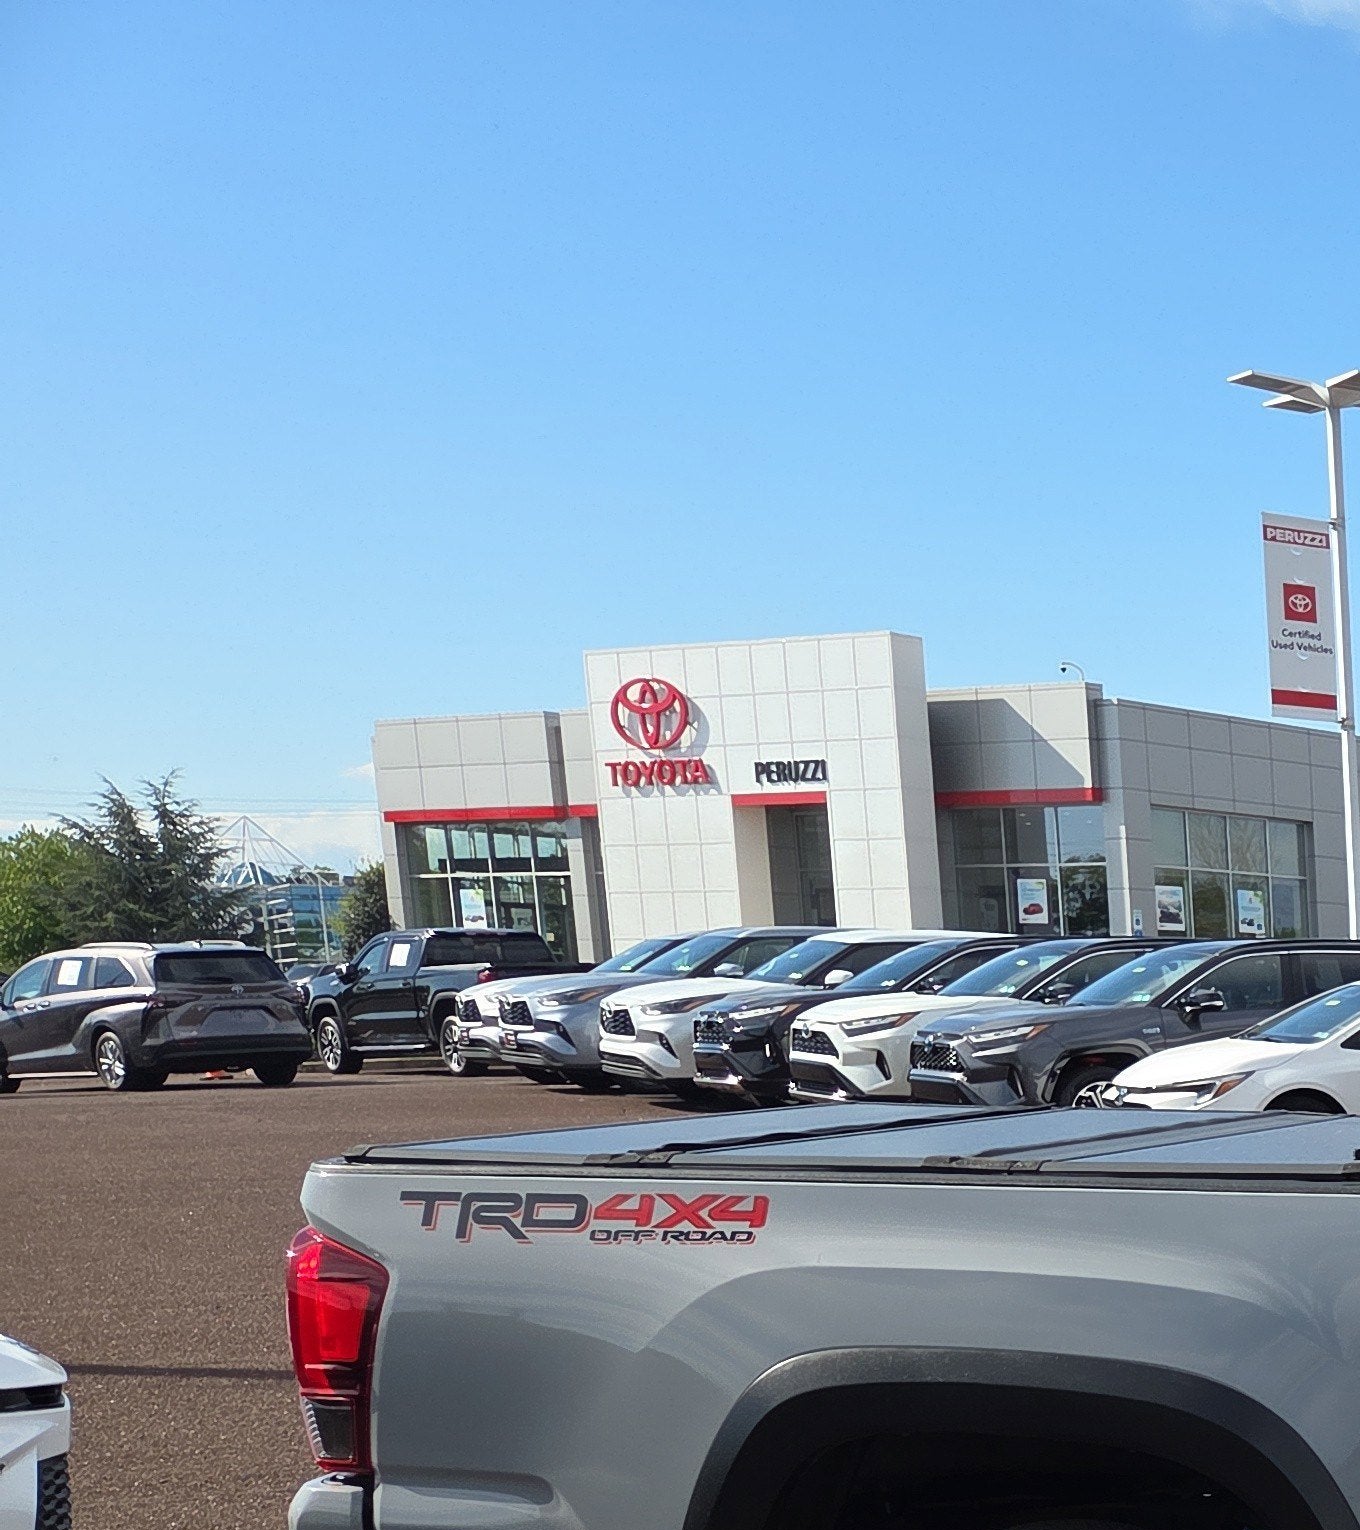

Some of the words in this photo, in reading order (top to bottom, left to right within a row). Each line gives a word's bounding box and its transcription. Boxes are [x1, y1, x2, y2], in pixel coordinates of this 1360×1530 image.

[1266, 527, 1326, 547] PERUZZI
[1281, 628, 1322, 641] Certified
[1271, 639, 1294, 650] Used
[1296, 642, 1333, 654] Vehicles
[605, 758, 711, 787] TOYOTA
[754, 759, 828, 783] PERUZZI
[400, 1191, 592, 1244] TRD
[593, 1193, 770, 1229] 4X4
[589, 1230, 656, 1245] OFF
[661, 1230, 756, 1245] ROAD
